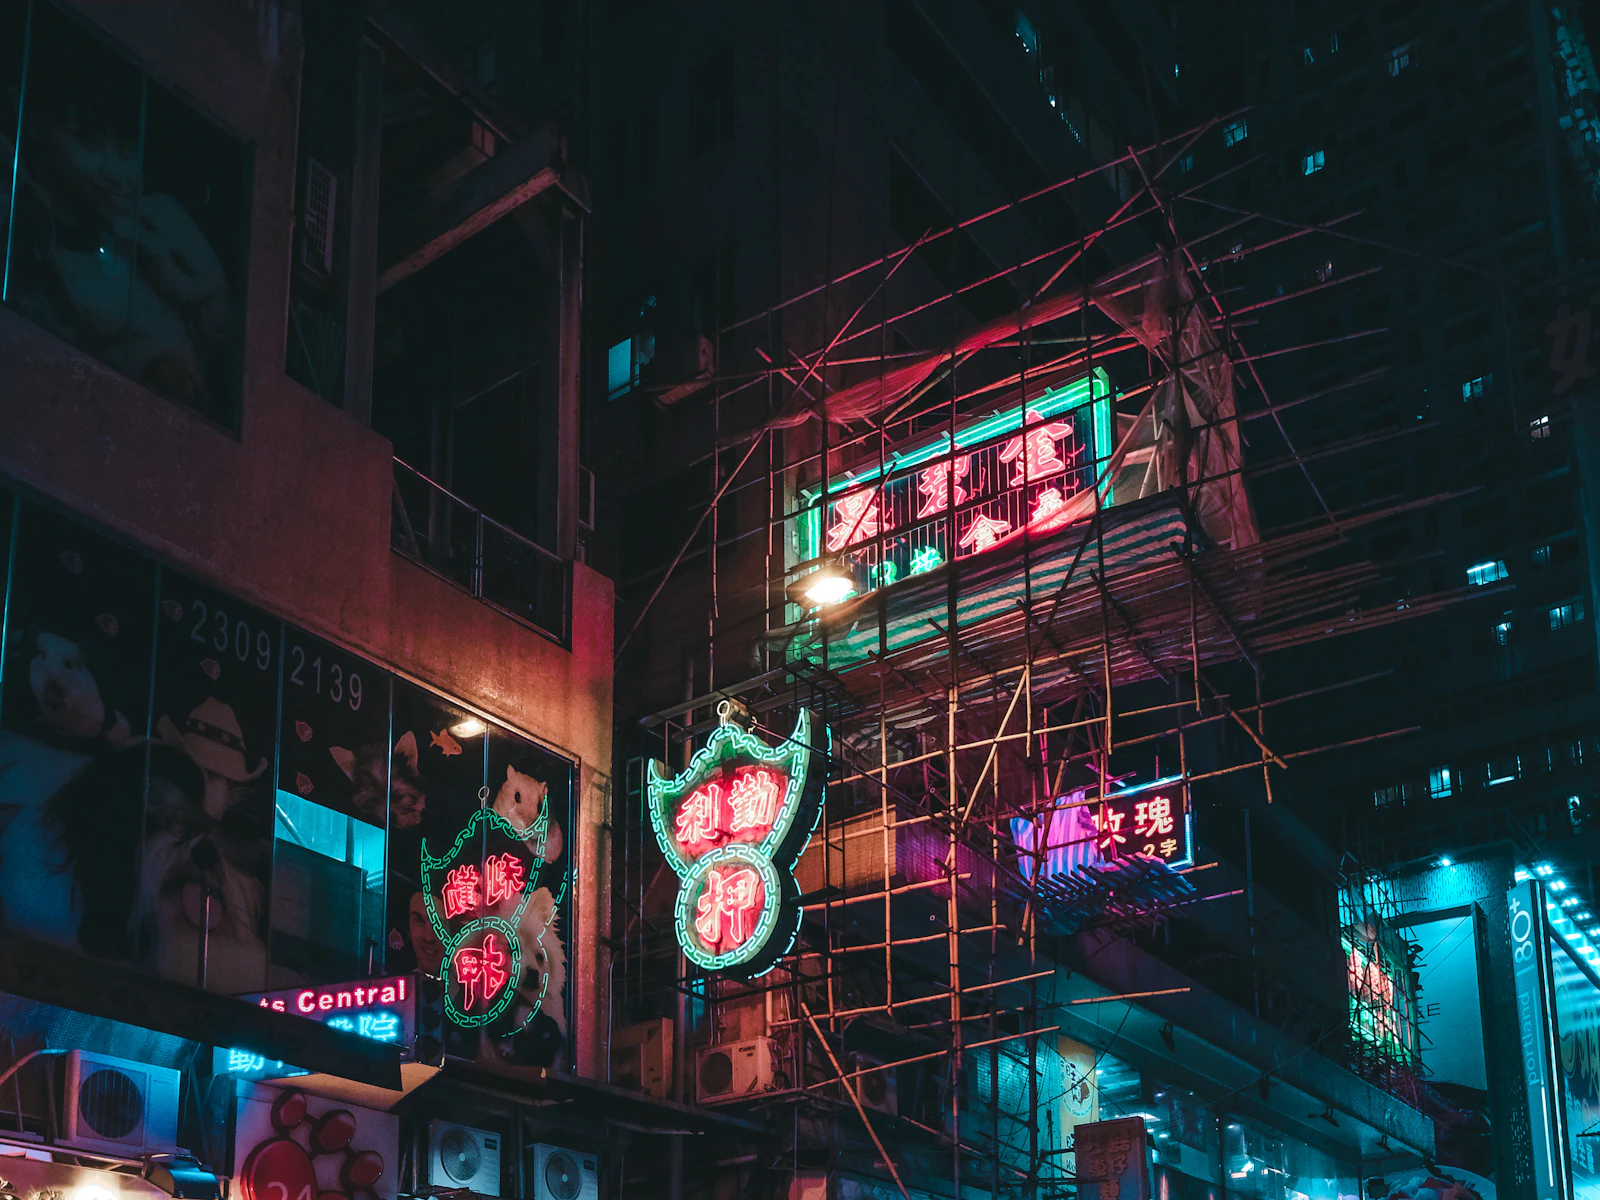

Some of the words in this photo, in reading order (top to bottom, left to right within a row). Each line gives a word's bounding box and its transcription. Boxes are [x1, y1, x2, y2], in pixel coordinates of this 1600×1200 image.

[190, 600, 271, 671] 2309
[290, 645, 362, 711] 2139
[695, 869, 760, 944] 押
[299, 979, 406, 1013] Central
[1518, 991, 1540, 1086] portland
